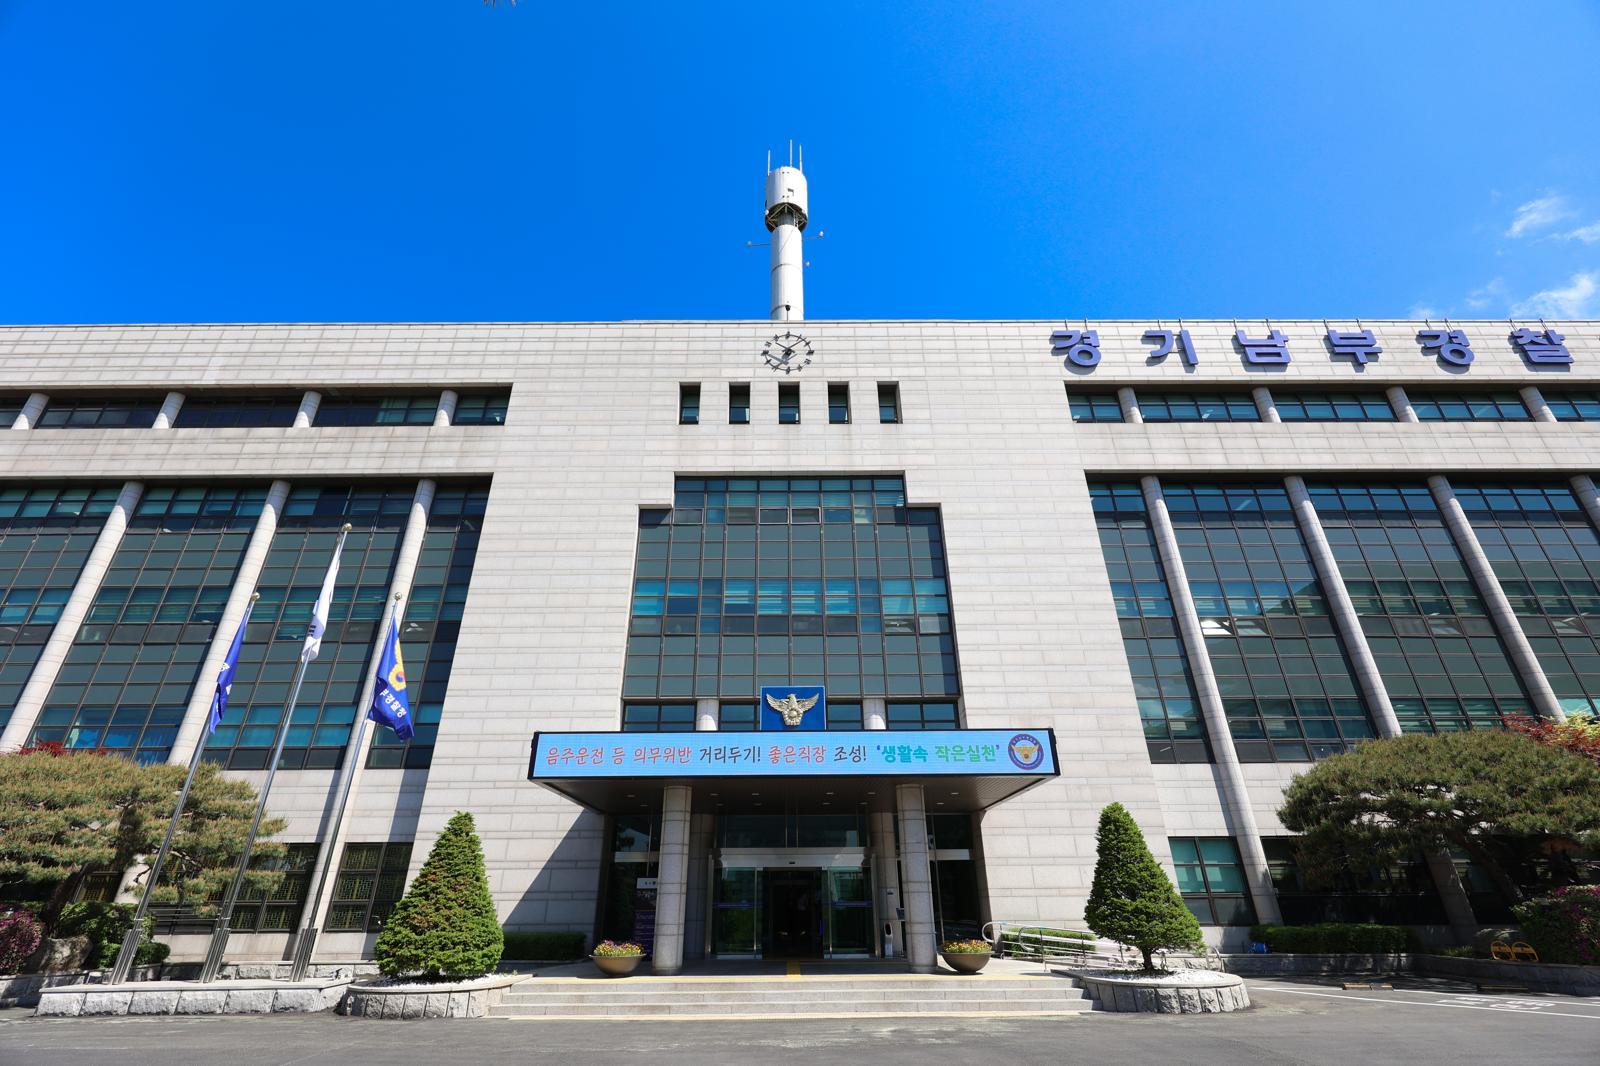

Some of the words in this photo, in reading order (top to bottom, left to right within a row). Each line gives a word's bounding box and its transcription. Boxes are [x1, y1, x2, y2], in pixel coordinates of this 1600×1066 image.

[546, 747, 604, 765] 음주운전
[612, 746, 626, 765] 등
[633, 745, 692, 765] 의무위반
[699, 745, 761, 764] 거리두기!
[768, 745, 827, 765] 좋은직장
[833, 745, 867, 763] 조성!
